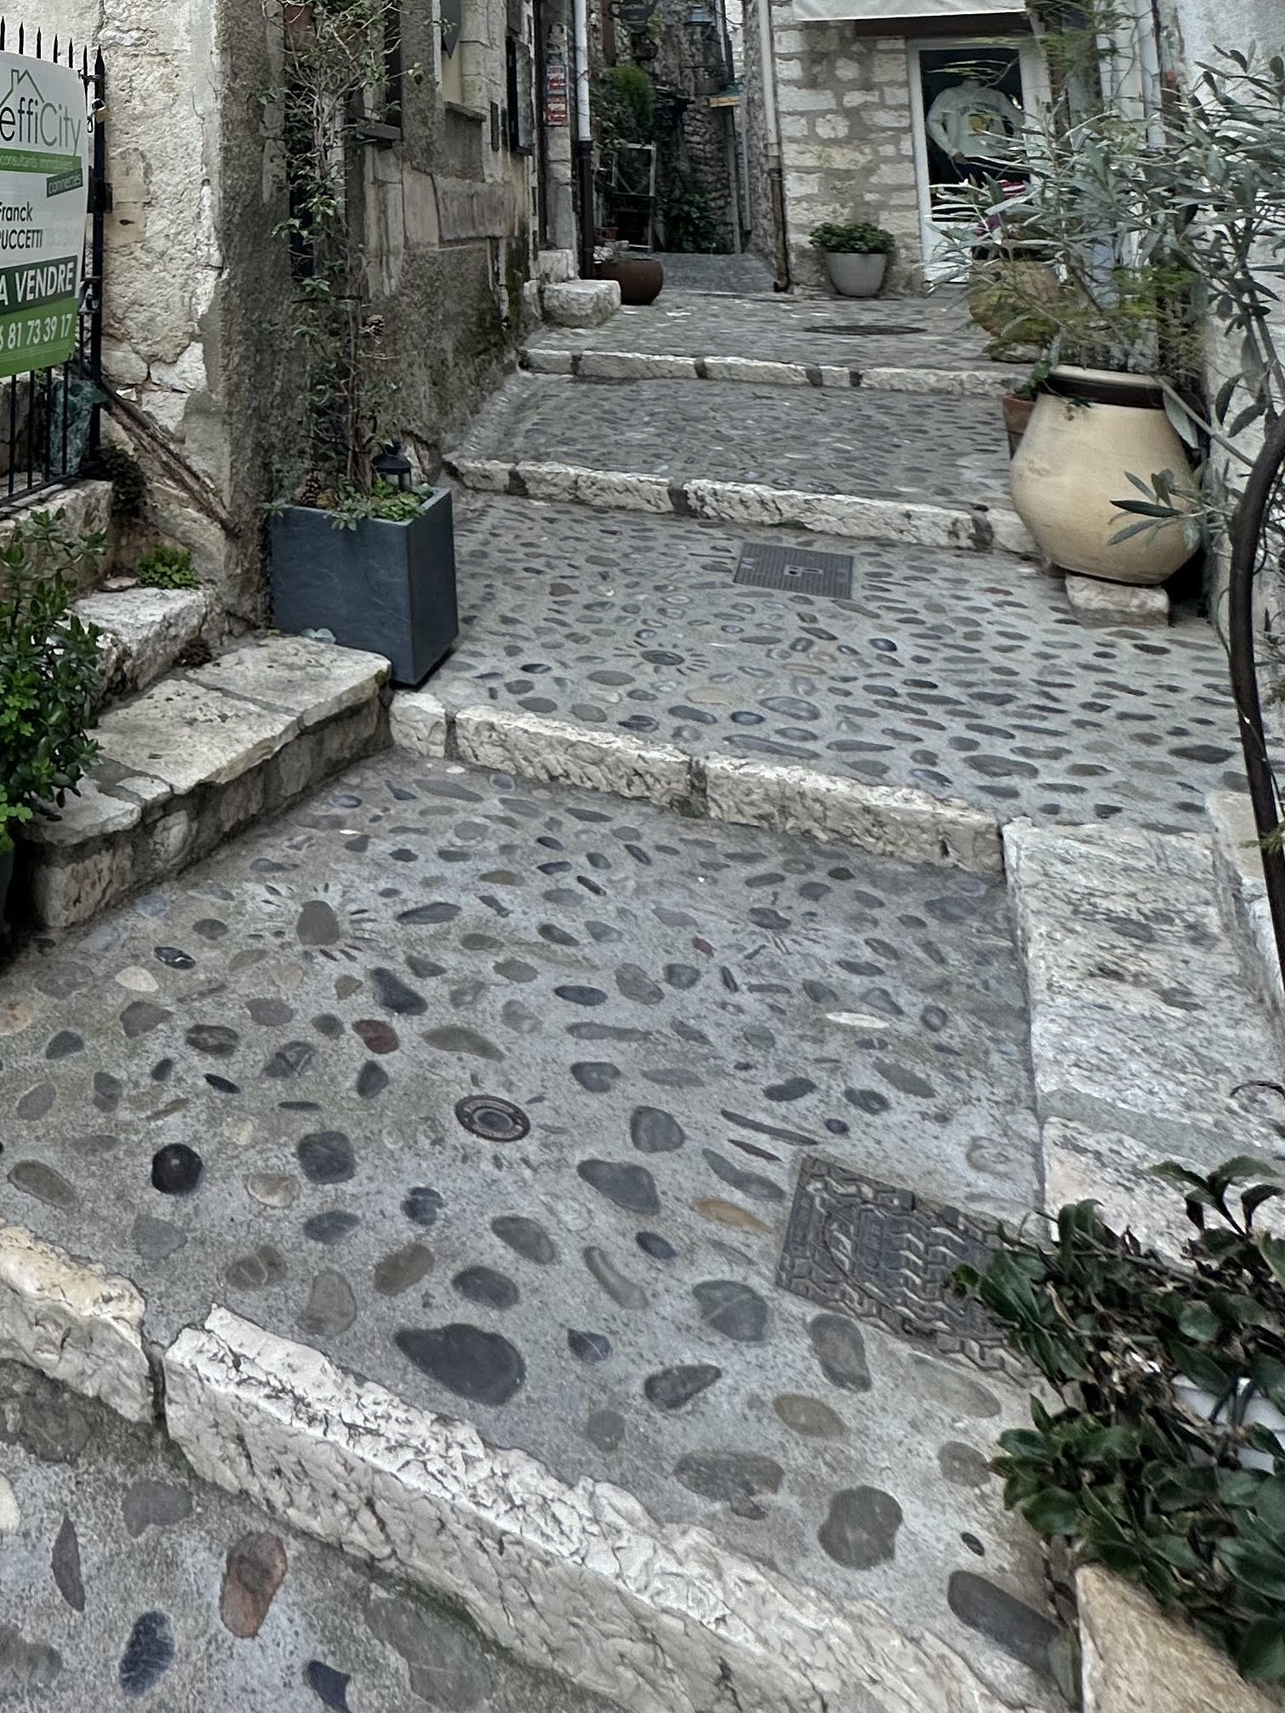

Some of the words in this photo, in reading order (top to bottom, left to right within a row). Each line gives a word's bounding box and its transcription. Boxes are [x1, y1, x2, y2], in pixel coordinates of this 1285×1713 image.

[15, 261, 75, 303] VENDRE
[7, 322, 22, 351] 81
[26, 319, 41, 345] 73
[43, 316, 57, 342] 39
[60, 313, 73, 338] 17
